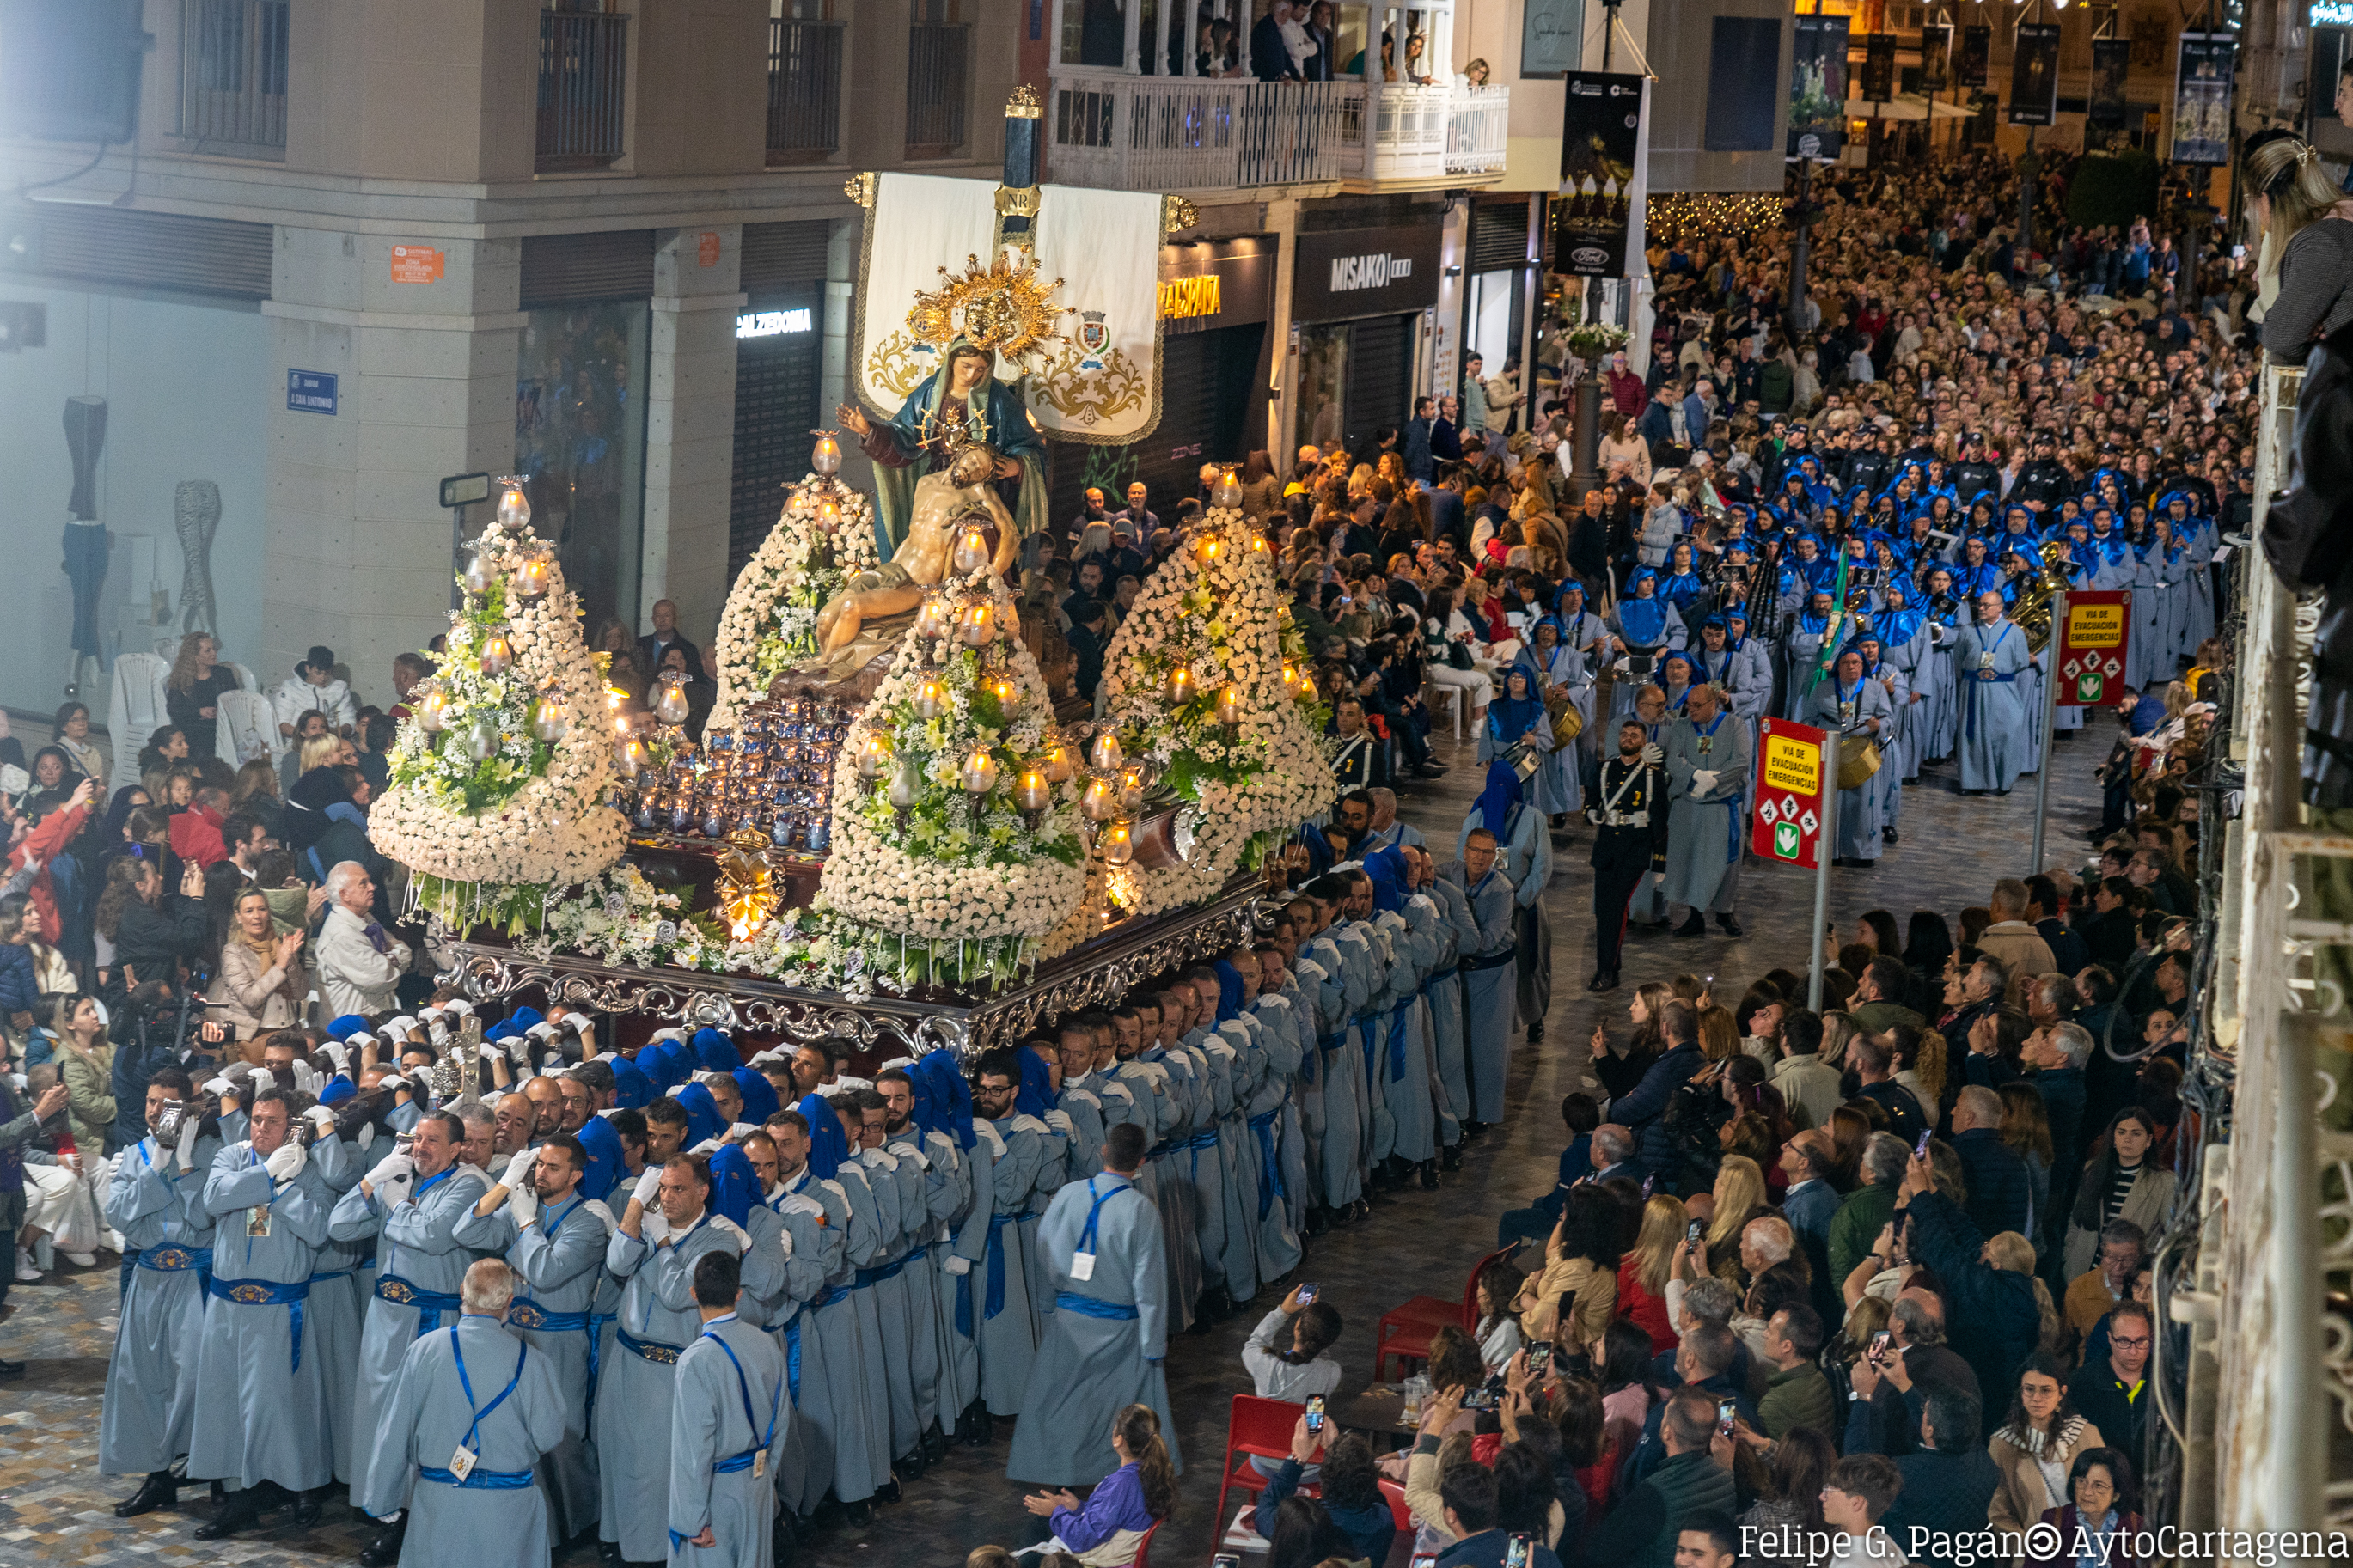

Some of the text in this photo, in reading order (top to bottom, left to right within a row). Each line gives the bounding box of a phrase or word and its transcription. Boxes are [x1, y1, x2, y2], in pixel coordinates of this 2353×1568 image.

[1329, 253, 1386, 292] MISAKO
[296, 394, 307, 405] SAN
[307, 395, 333, 409] ANTONIO
[2099, 610, 2109, 619] DE
[2070, 632, 2119, 642] EMERGENCIAS
[1795, 748, 1806, 760] DE
[1771, 756, 1814, 776] EVACUACIÓN
[1768, 770, 1816, 790] EMERGENCIAS
